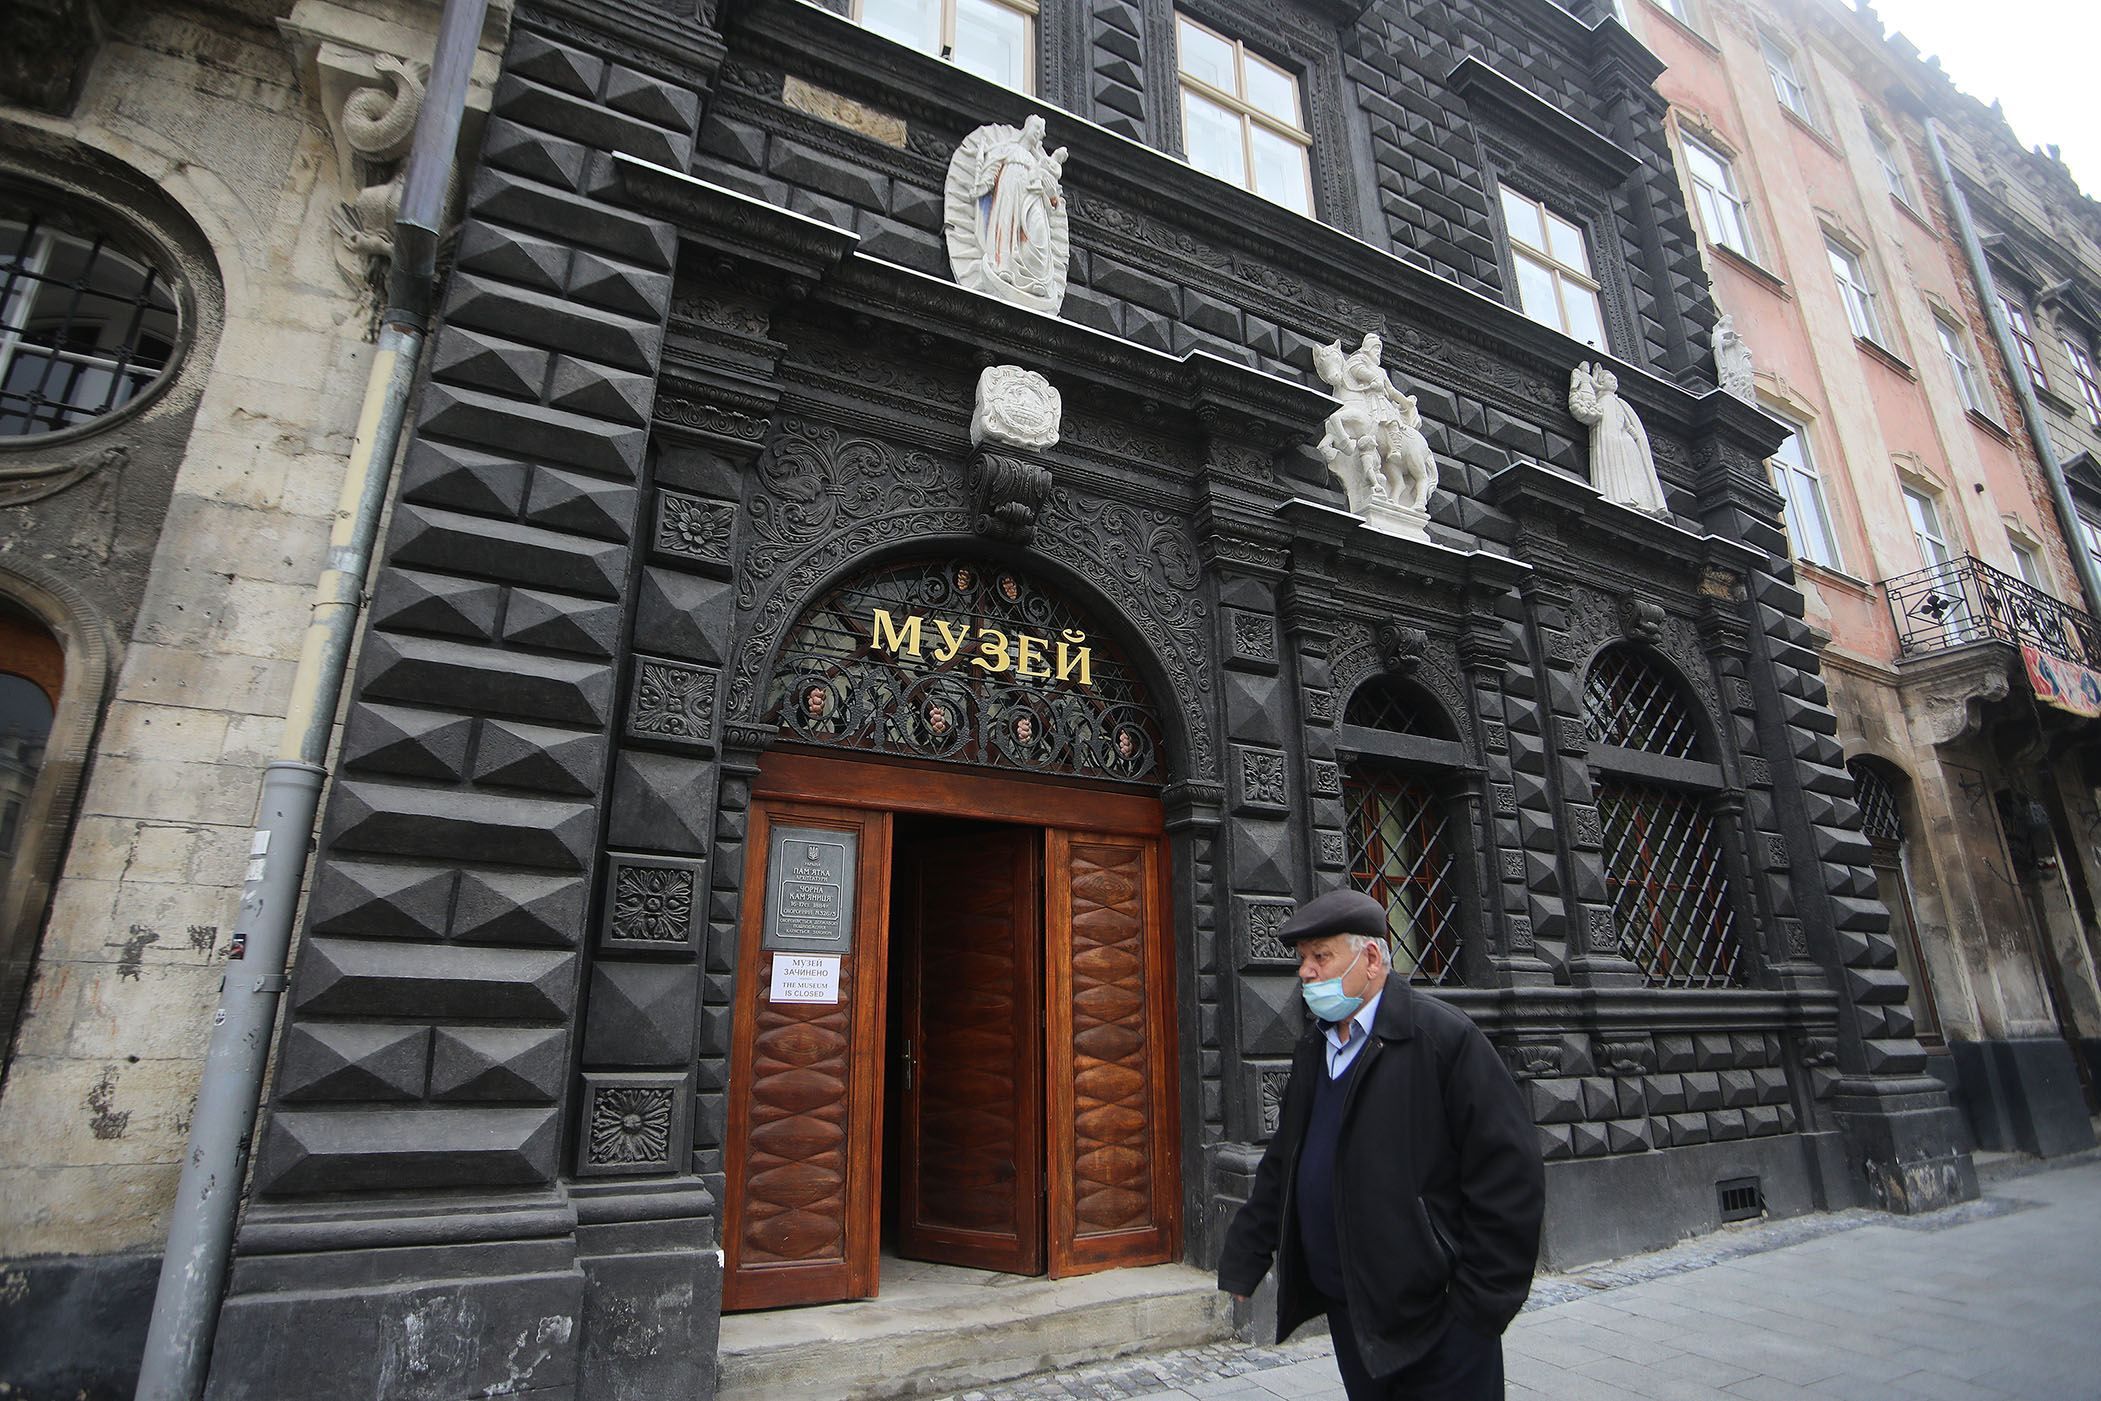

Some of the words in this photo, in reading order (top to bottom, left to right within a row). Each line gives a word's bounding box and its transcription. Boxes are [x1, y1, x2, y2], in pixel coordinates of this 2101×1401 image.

[870, 608, 1093, 685] МУЗЕЙ
[792, 958, 823, 968] МУЗЕЙ
[783, 968, 829, 977] ЗАЧИНЕНО
[794, 990, 824, 998] CLOSED
